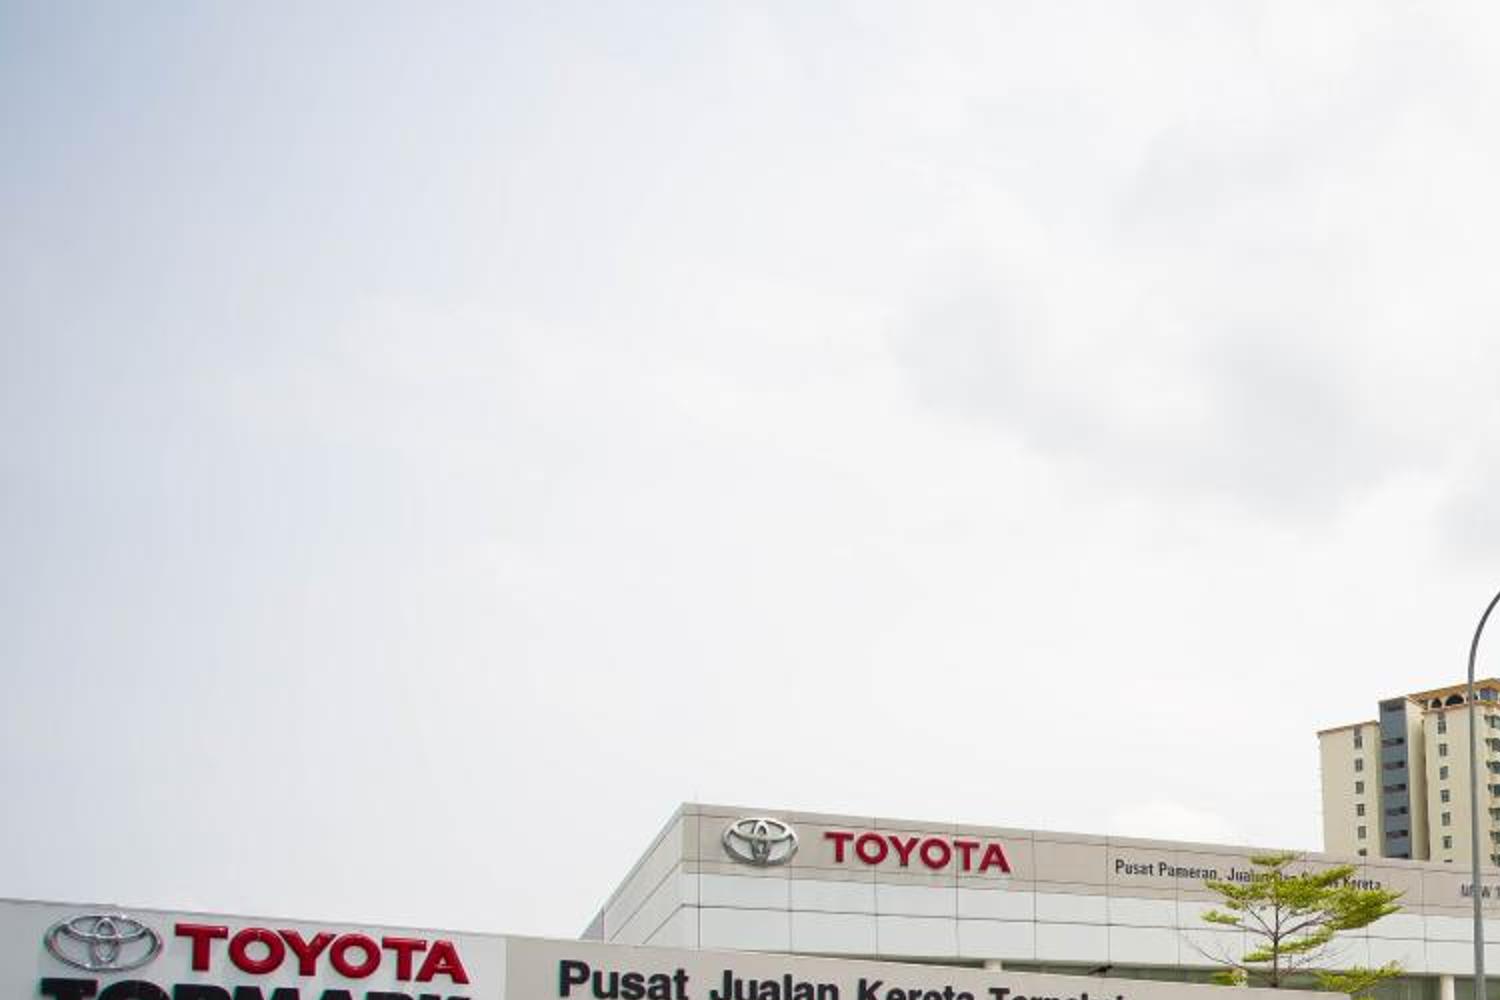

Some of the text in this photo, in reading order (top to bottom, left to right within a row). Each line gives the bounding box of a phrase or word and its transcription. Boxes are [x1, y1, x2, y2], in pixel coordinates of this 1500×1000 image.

[824, 831, 1011, 873] TOYOTA
[1115, 859, 1154, 877] Pusat
[175, 923, 470, 985] TOYOTA
[559, 960, 689, 1000] Pusat
